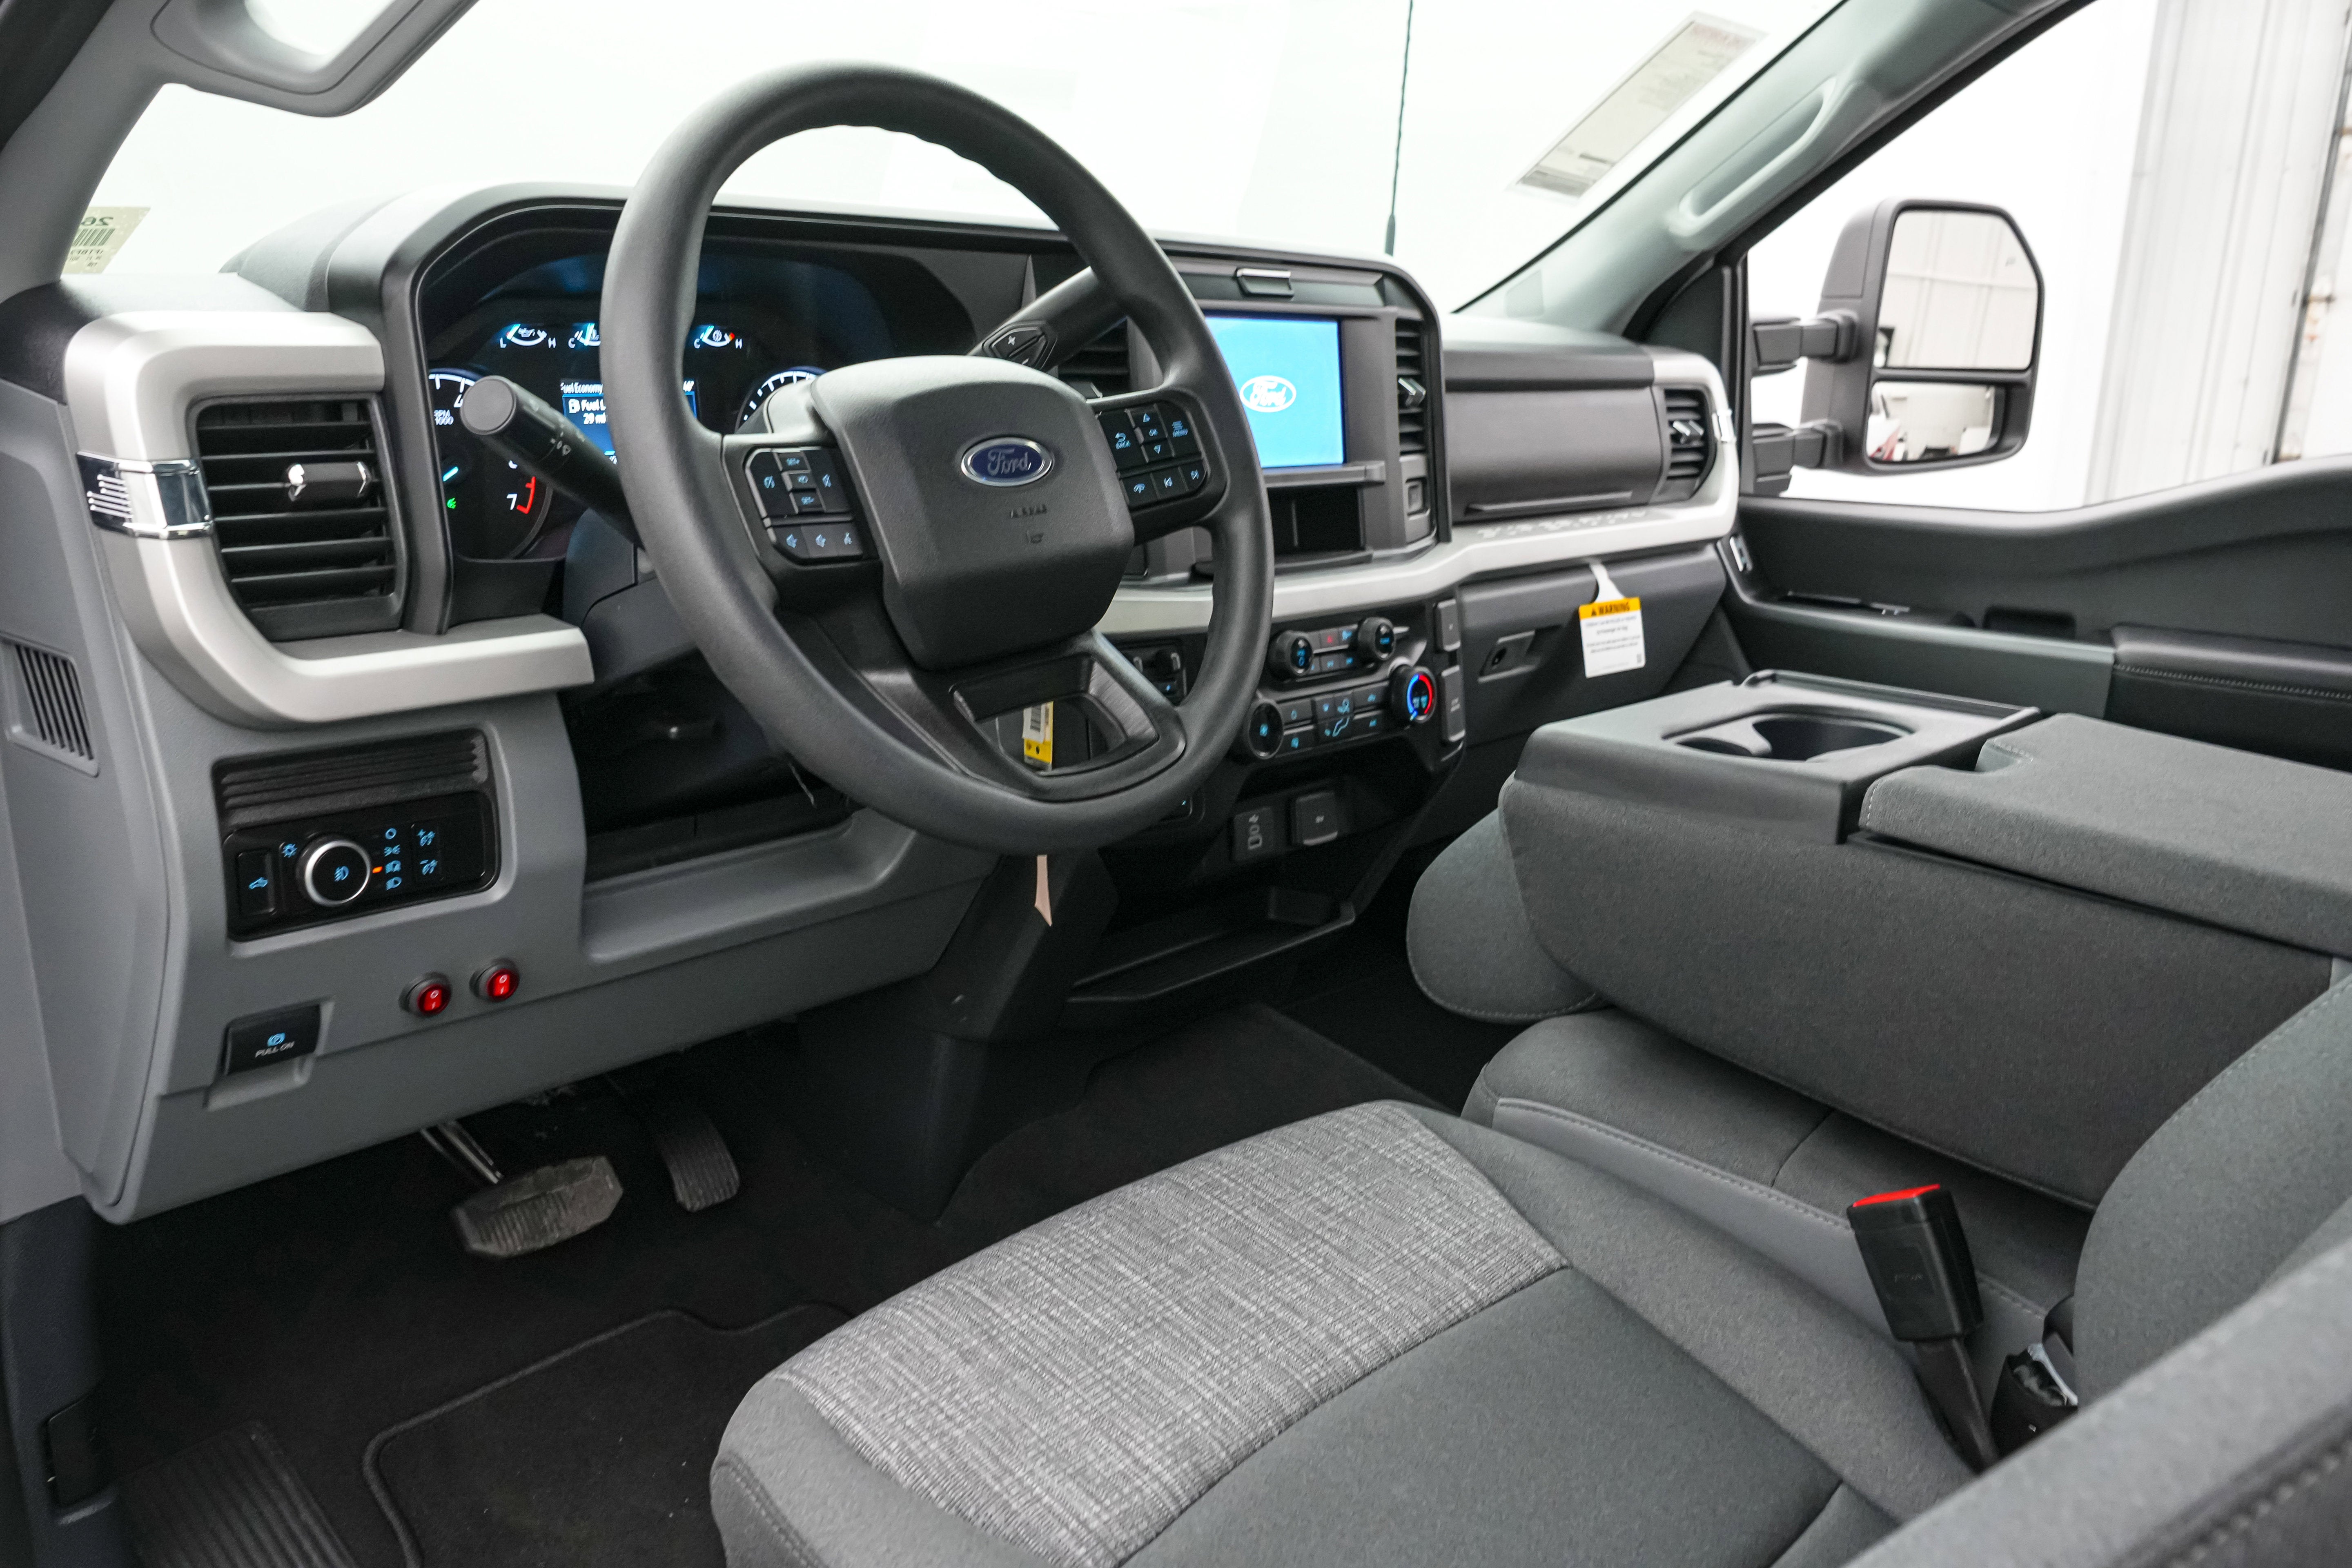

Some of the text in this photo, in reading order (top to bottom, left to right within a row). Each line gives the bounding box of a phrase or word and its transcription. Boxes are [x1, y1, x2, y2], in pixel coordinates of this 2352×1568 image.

[499, 337, 556, 348] L H
[568, 337, 575, 348] C
[693, 338, 742, 349] C H
[581, 399, 600, 411] Fuel
[506, 493, 518, 510] 7
